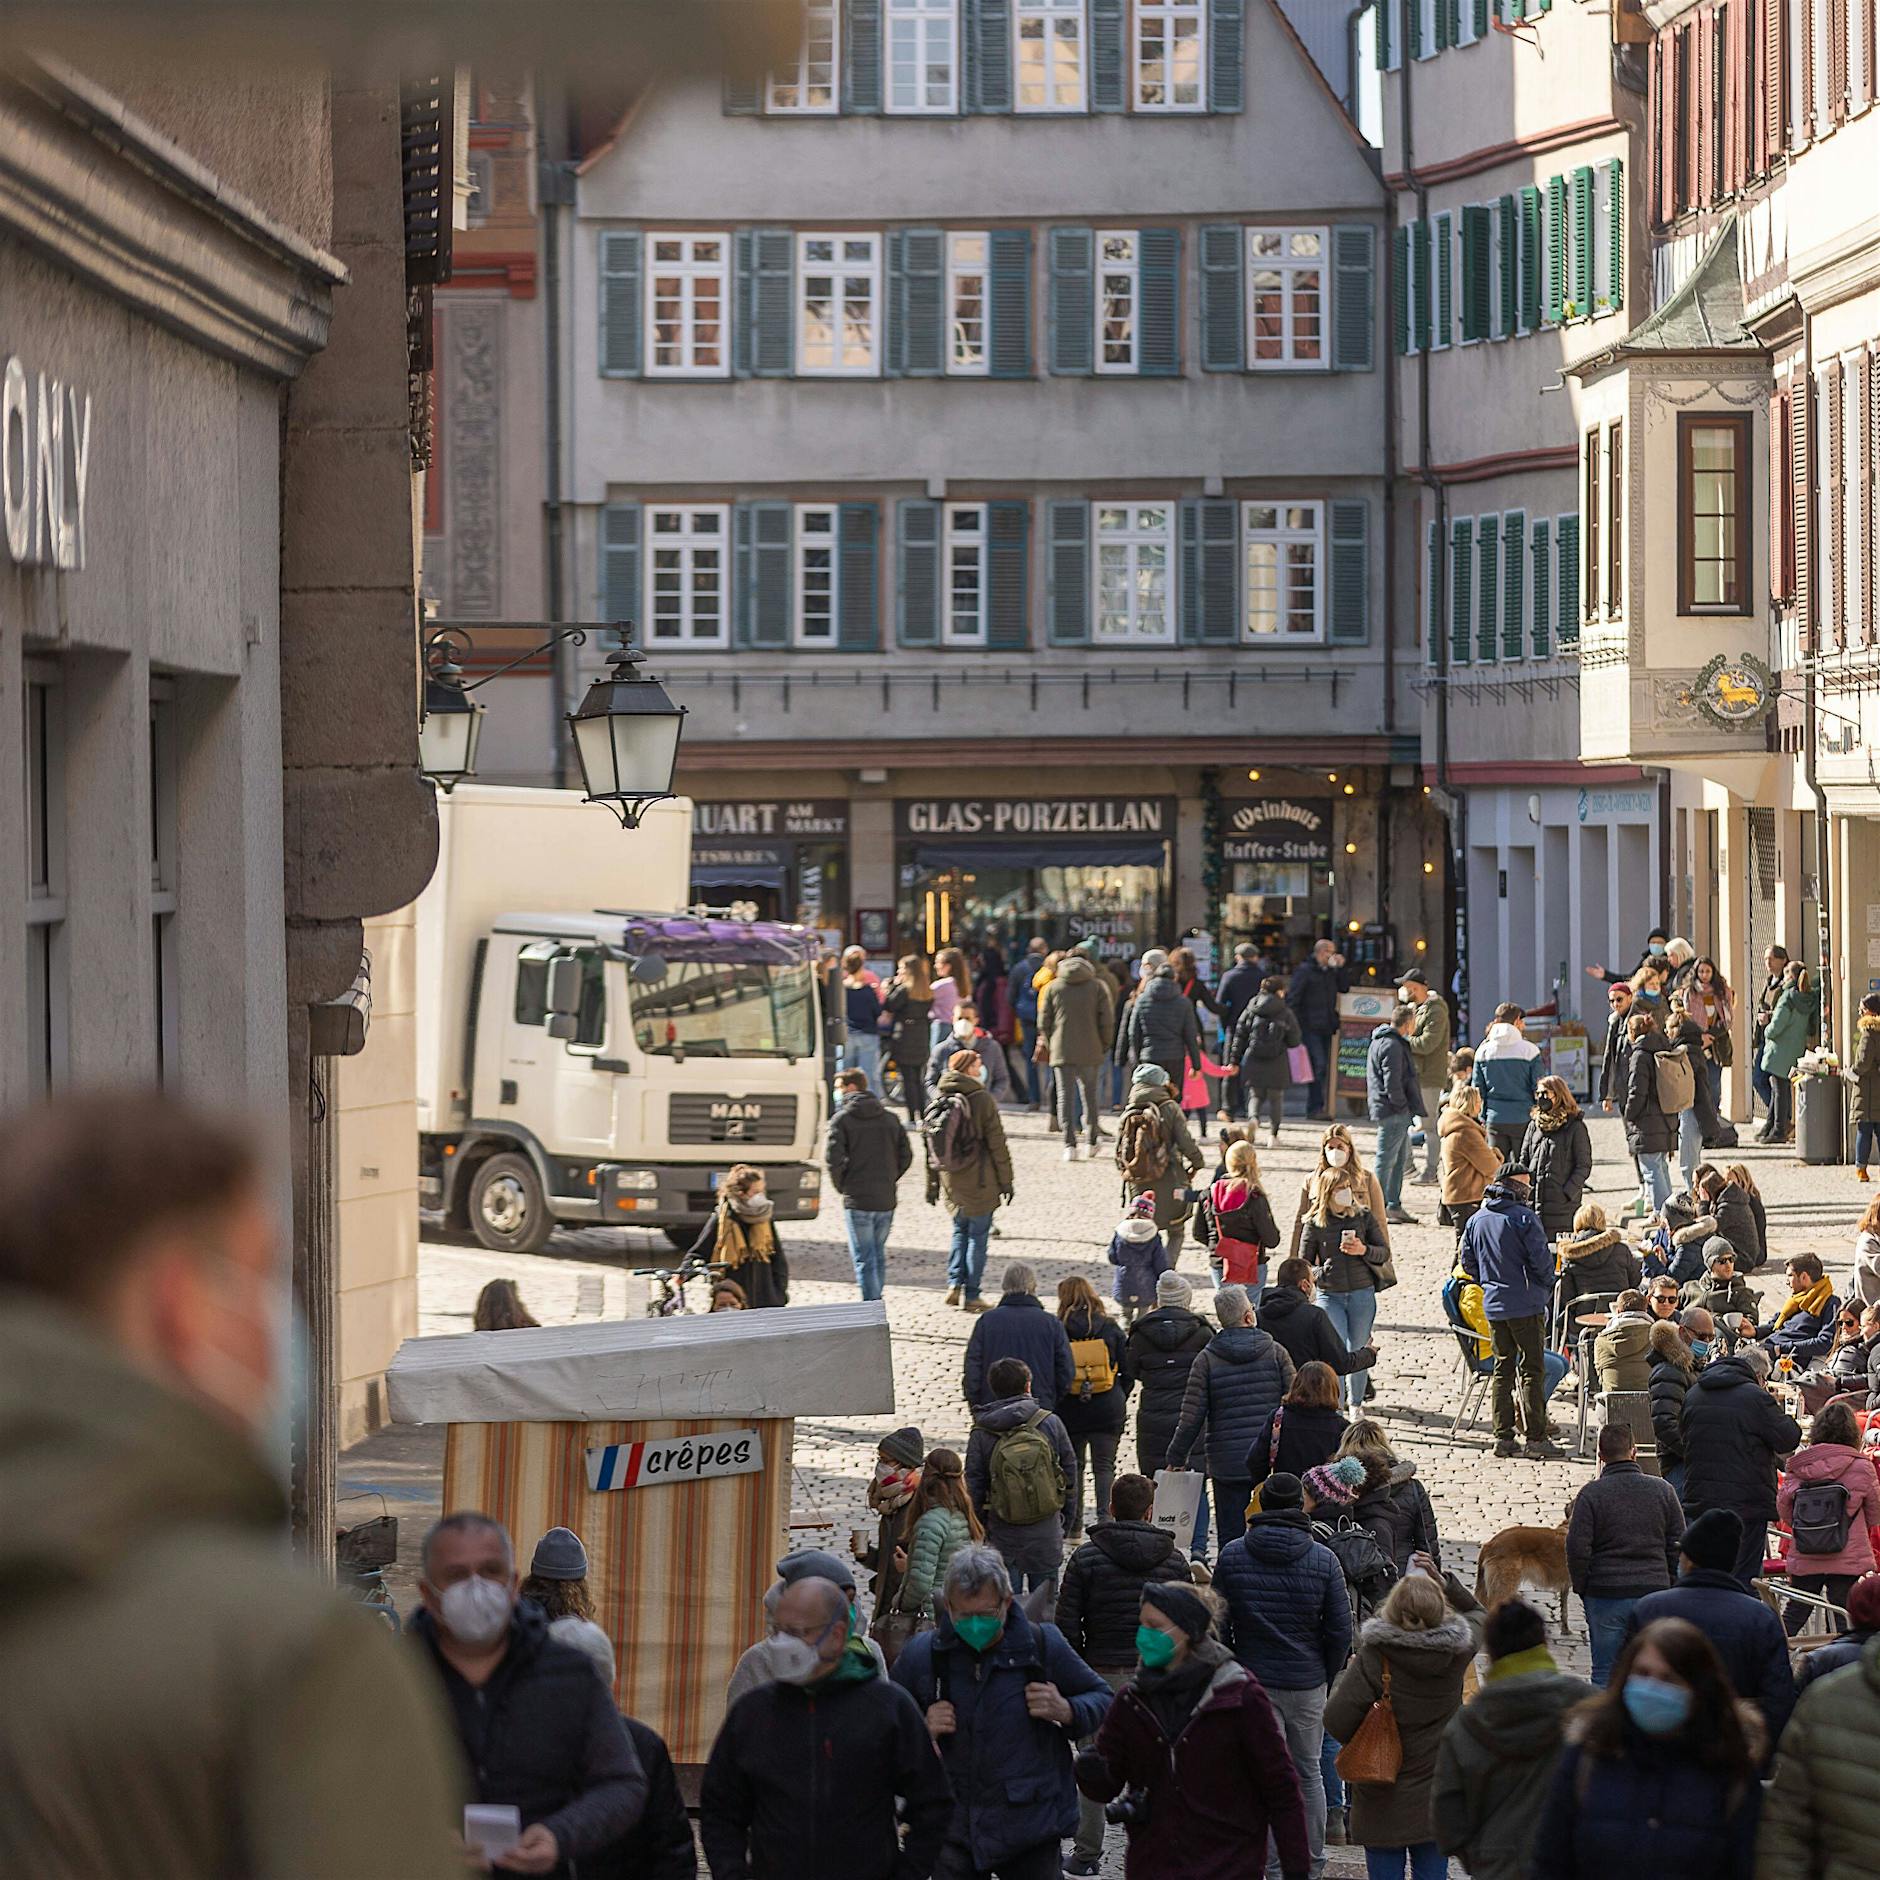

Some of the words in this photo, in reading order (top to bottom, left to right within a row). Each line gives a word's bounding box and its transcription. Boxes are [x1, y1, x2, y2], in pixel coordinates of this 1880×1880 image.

[3, 355, 92, 571] ONLY
[786, 804, 815, 818] AM
[1232, 800, 1322, 831] Weinhaus
[785, 818, 845, 832] MARKT
[1223, 841, 1328, 858] Kaffee-Stube
[1069, 917, 1134, 938] Spirits
[1099, 938, 1135, 959] hop
[711, 1103, 761, 1119] MAN
[646, 1440, 751, 1474] crêpes
